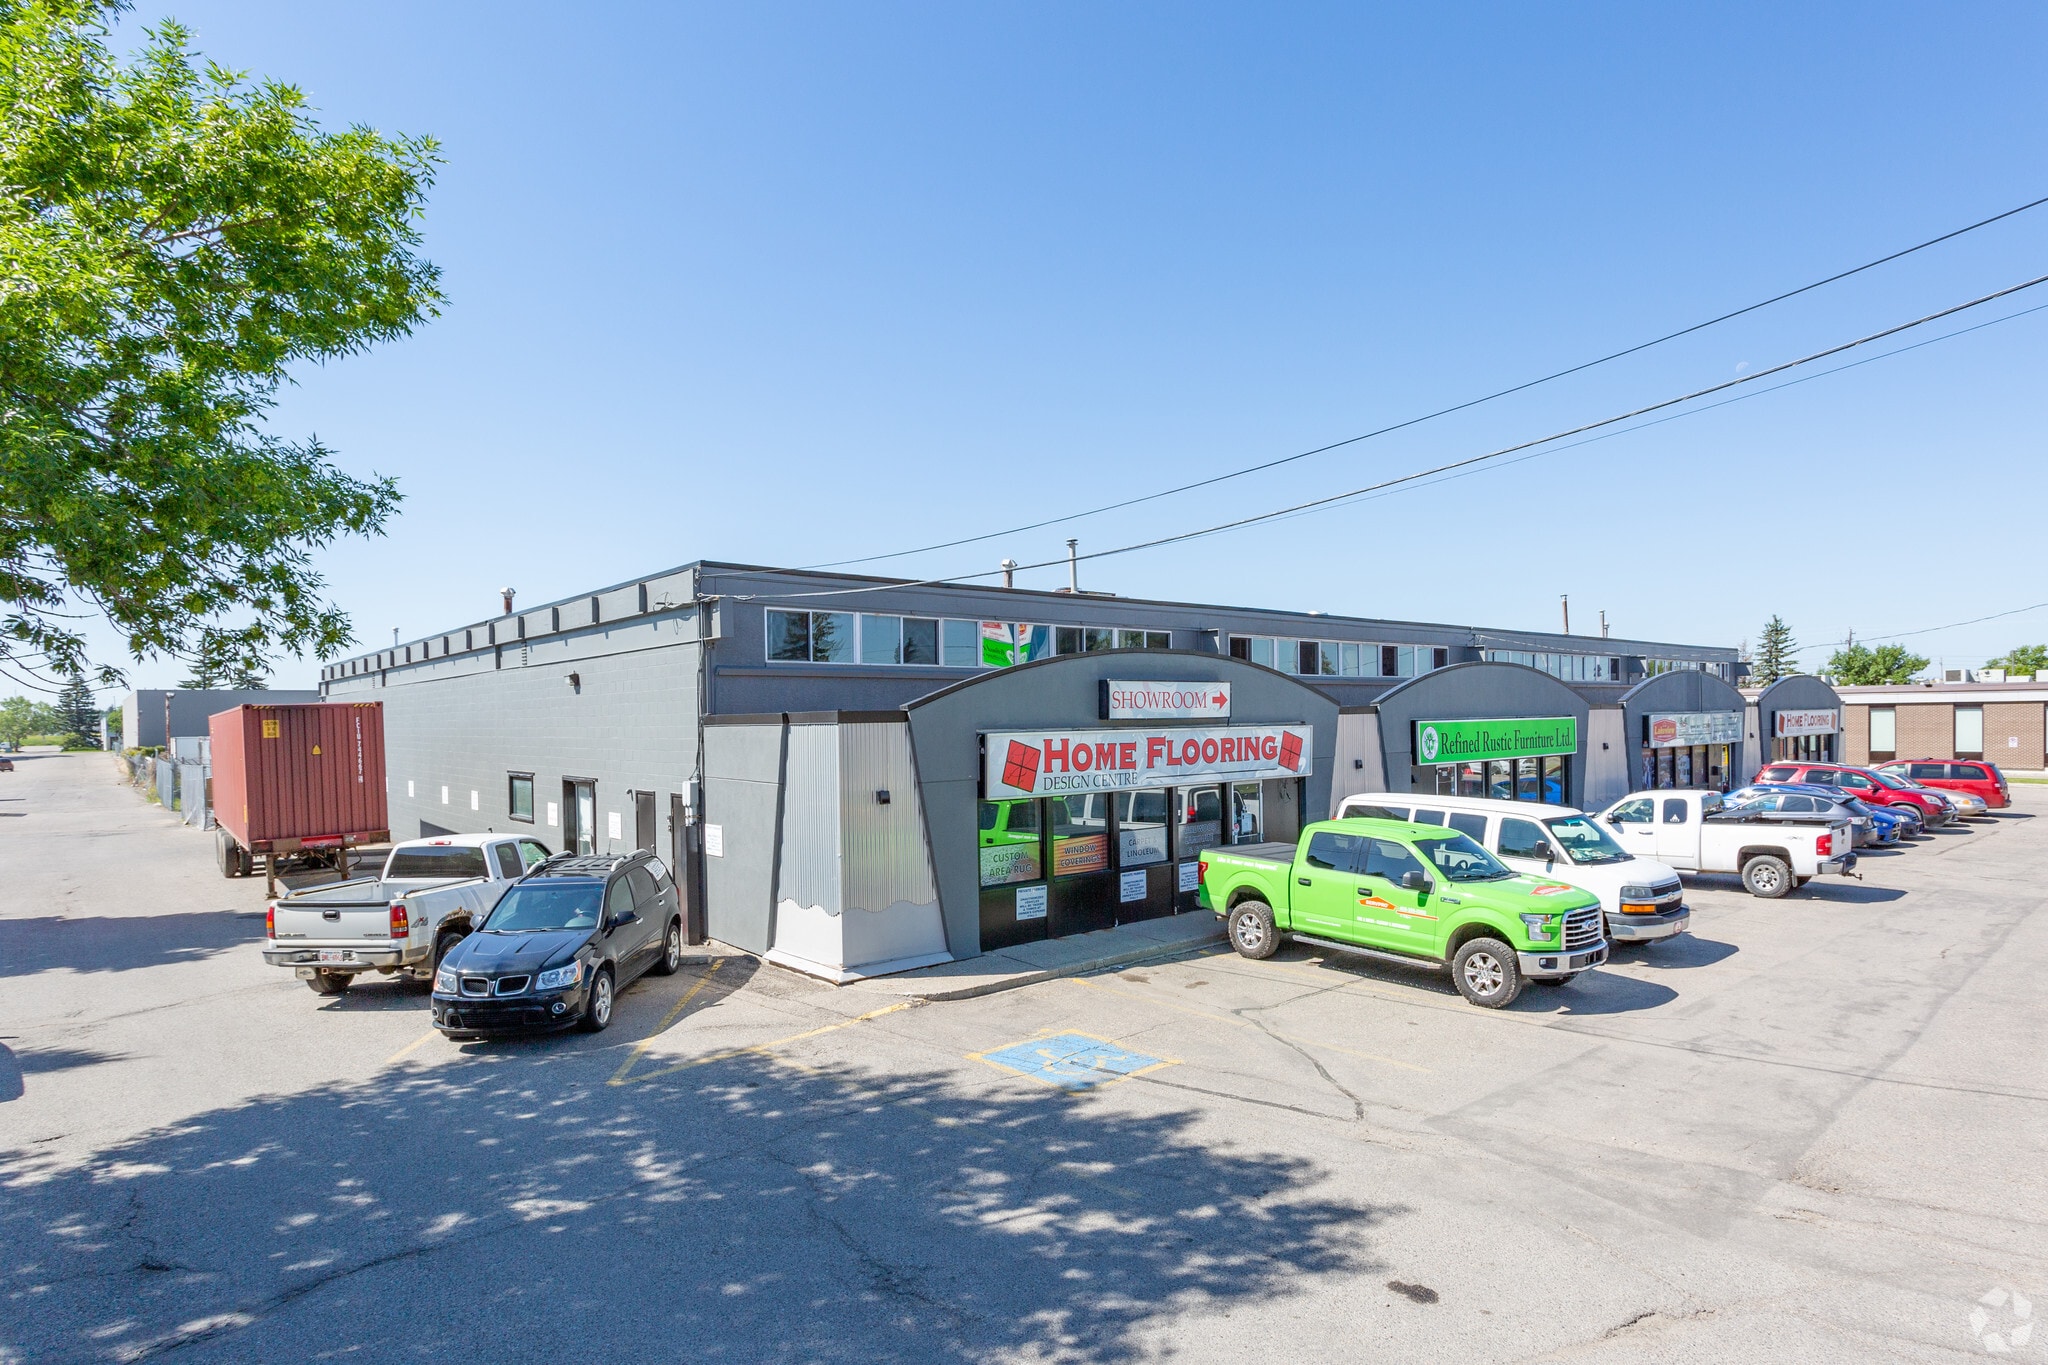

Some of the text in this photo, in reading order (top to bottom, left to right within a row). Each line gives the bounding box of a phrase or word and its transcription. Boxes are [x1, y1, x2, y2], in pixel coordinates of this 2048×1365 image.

[1112, 690, 1208, 710] SHOWROOM
[1441, 727, 1573, 755] Refined Rustic Furniture Ltd.
[1043, 735, 1278, 774] HOME FLOORING
[1043, 771, 1138, 791] DESIGN CENTRE
[1064, 844, 1098, 855] WINDOW
[1127, 848, 1160, 858] LINOLEUM
[993, 851, 1029, 863] CUSTOM
[1060, 855, 1101, 867] COVERINGS
[989, 863, 1032, 877] AREA RUG
